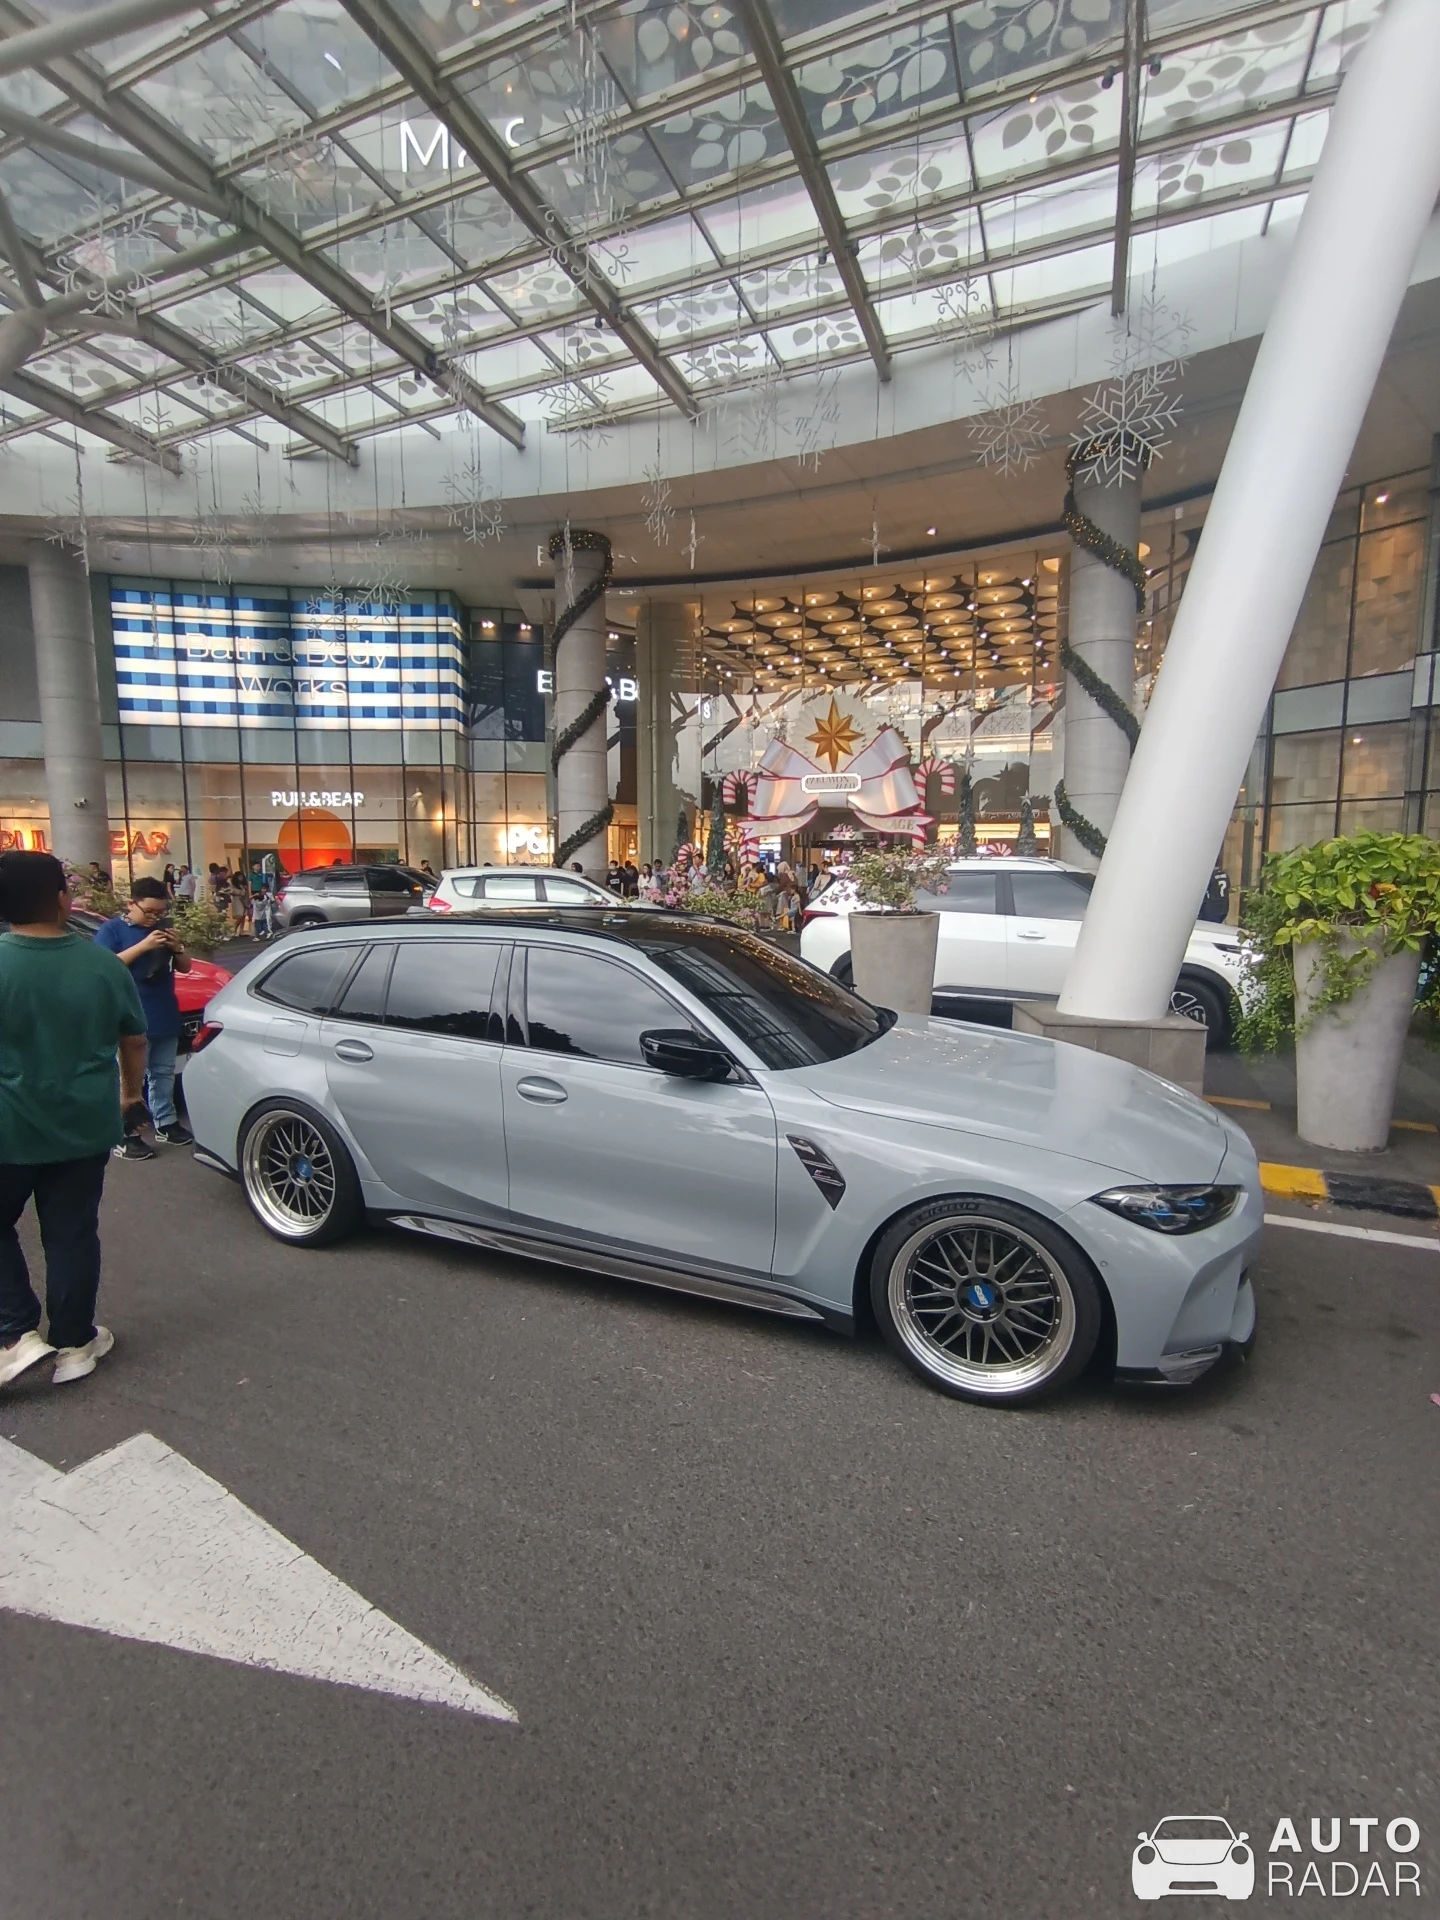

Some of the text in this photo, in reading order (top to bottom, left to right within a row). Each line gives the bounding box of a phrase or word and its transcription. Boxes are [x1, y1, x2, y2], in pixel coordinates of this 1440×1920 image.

[185, 632, 390, 670] Bath & Body
[237, 672, 347, 700] Works
